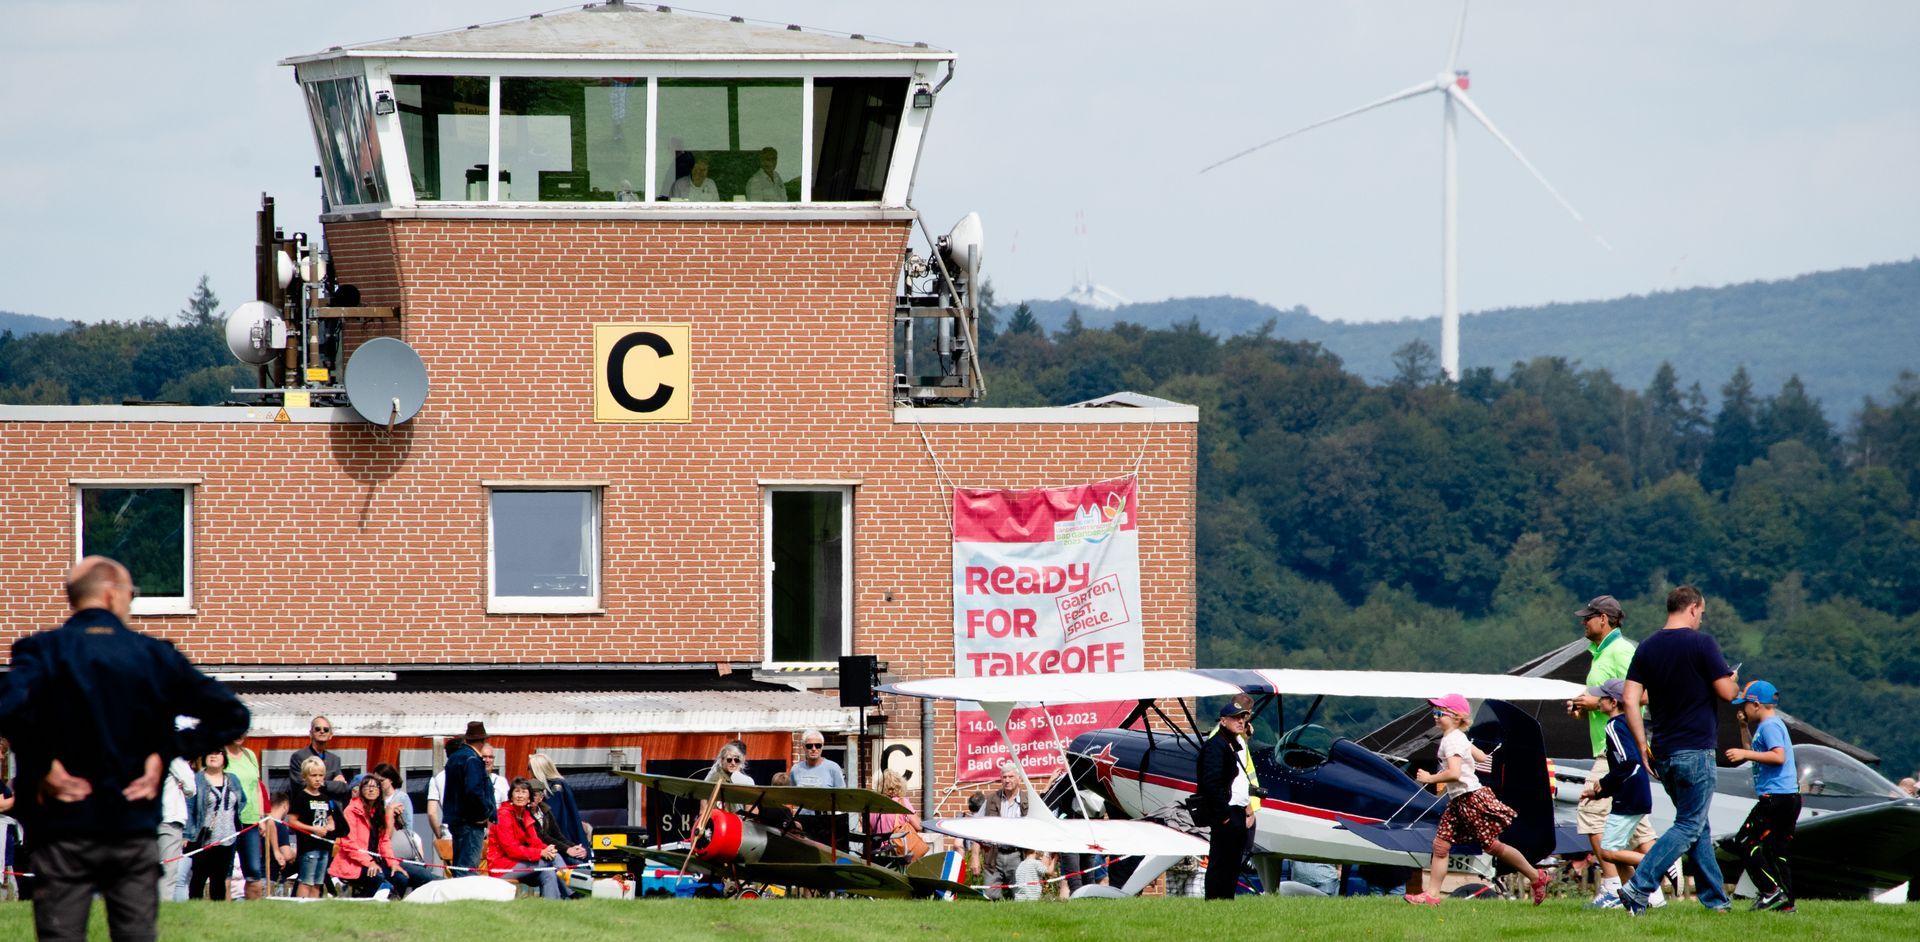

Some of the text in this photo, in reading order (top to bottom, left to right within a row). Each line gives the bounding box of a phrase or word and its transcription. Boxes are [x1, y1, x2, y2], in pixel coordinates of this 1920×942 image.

[606, 332, 675, 413] C
[966, 607, 1038, 639] FOR
[1008, 719, 1026, 730] bis
[881, 744, 913, 782] C
[967, 757, 993, 771] Bad
